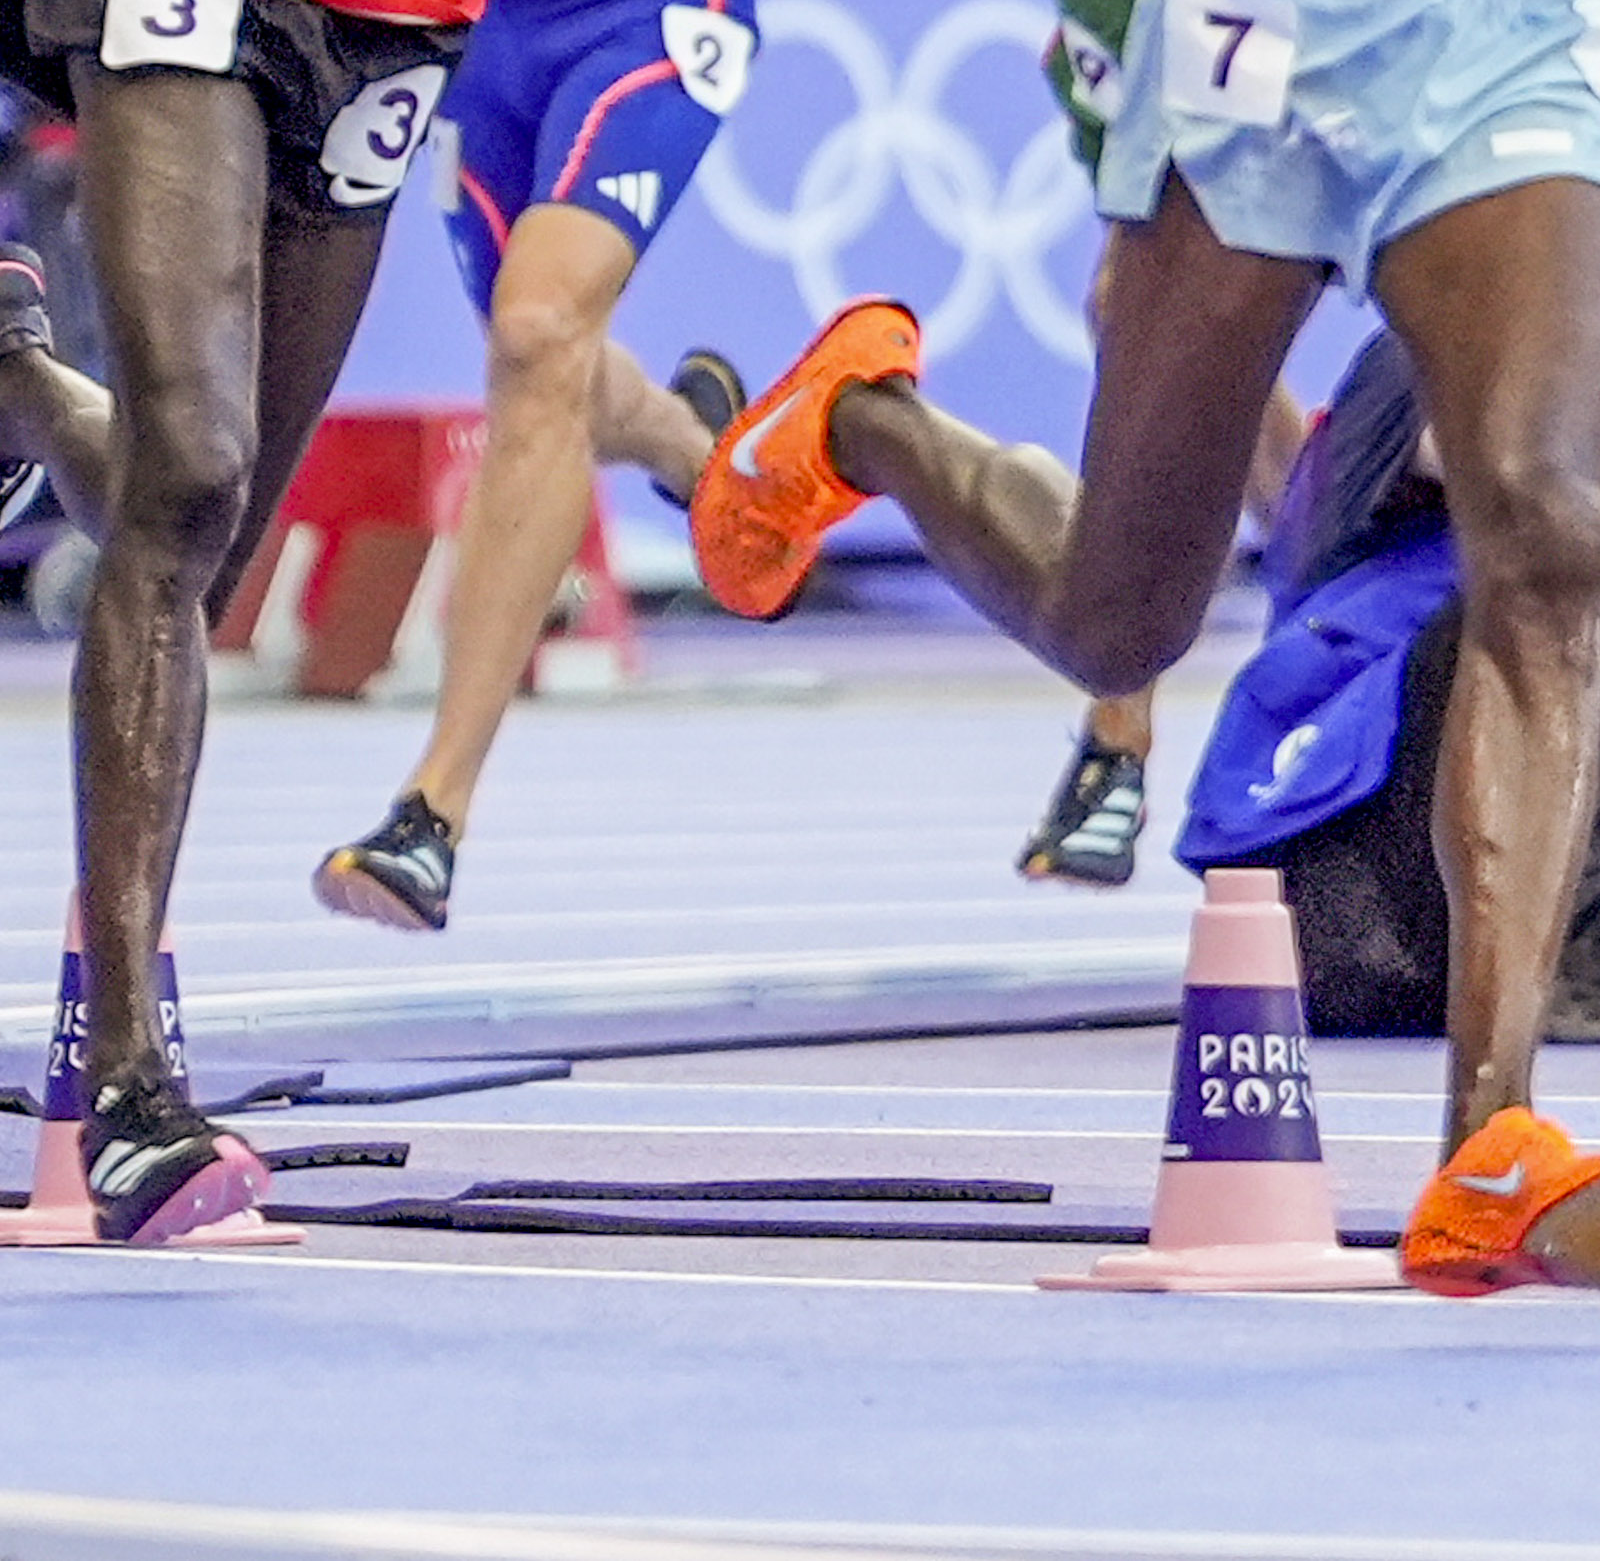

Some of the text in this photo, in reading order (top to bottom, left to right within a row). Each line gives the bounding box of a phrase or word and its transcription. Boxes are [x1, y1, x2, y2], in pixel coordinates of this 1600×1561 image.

[693, 33, 722, 87] 2
[1204, 9, 1255, 89] 7
[366, 87, 419, 160] 3
